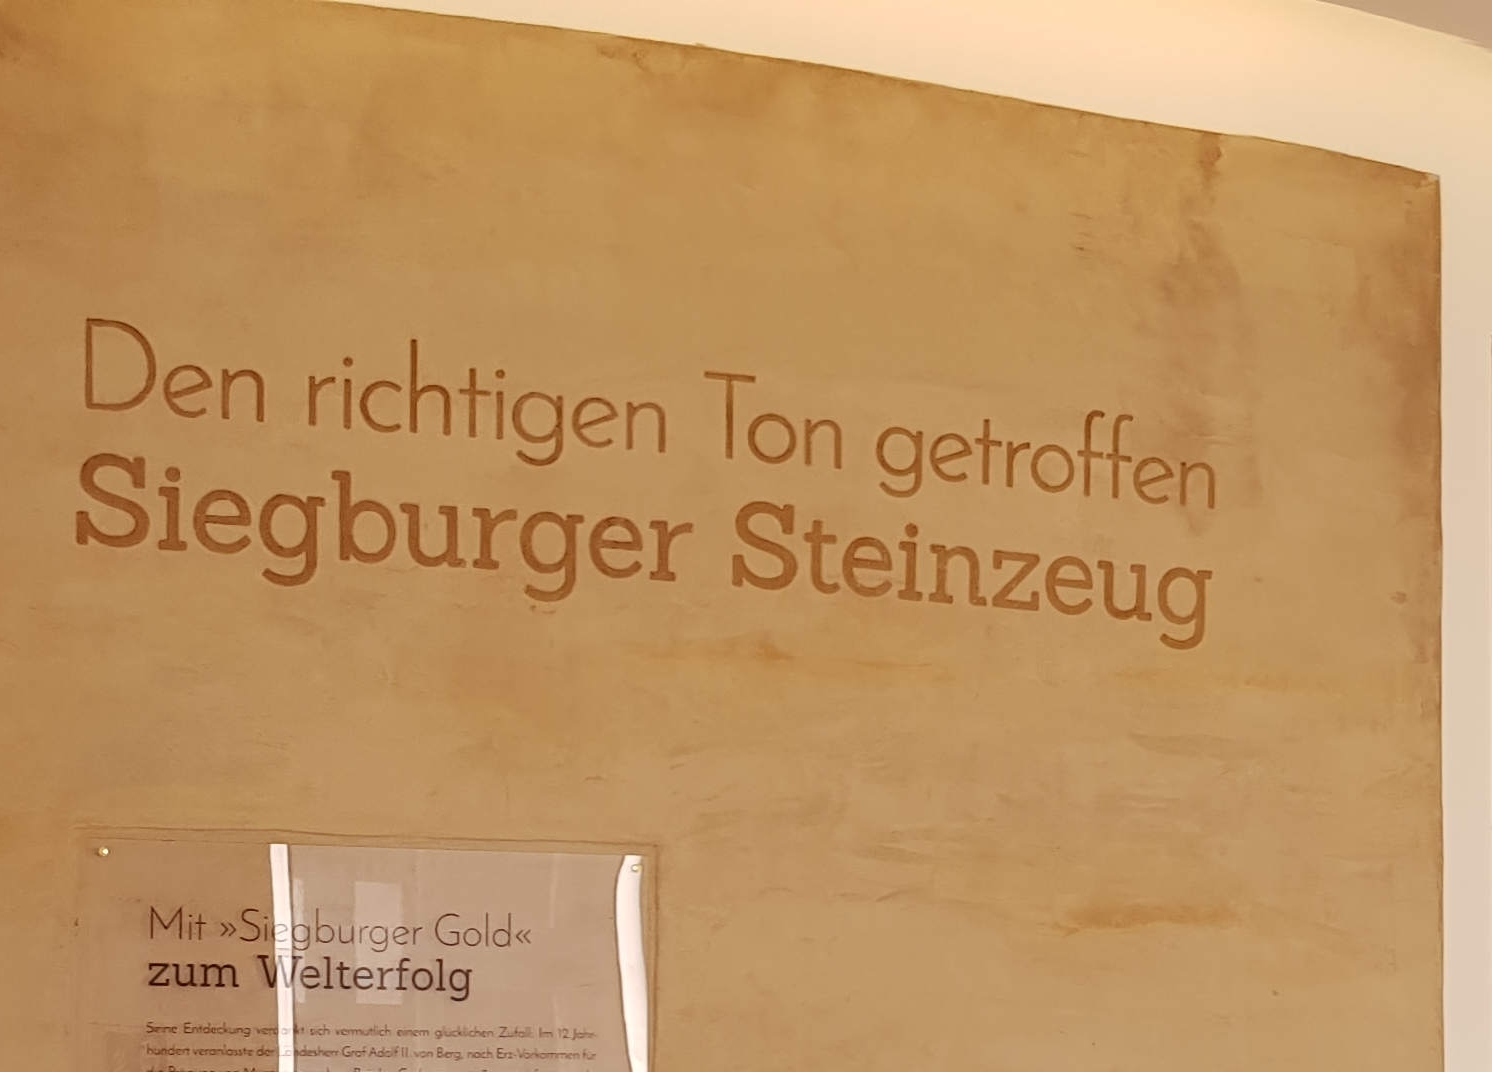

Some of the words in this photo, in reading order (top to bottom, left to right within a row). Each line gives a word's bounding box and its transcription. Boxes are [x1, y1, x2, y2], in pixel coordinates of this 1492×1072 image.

[84, 316, 265, 423] Den
[306, 339, 668, 468] richtigen
[704, 372, 843, 469] Ton
[874, 407, 1219, 510] getroffen
[75, 453, 695, 603] Siegburger
[731, 501, 1215, 649] Steinzeug
[150, 906, 207, 940] Mit
[220, 908, 423, 953] »Siegburger
[434, 912, 532, 948] Gold«
[148, 962, 239, 987] zum
[257, 955, 473, 1001] Welterfolg
[146, 1044, 190, 1056] hundert
[193, 1046, 254, 1057] veranlasste
[257, 1046, 275, 1057] der
[341, 1045, 366, 1058] Graf
[369, 1046, 399, 1058] Adolf
[414, 1050, 433, 1058] von
[467, 1048, 493, 1060] nach
[183, 1022, 251, 1037] Entdeckung
[310, 1024, 330, 1036] sich
[335, 1025, 391, 1037] vermutlich
[397, 1028, 430, 1038] einem
